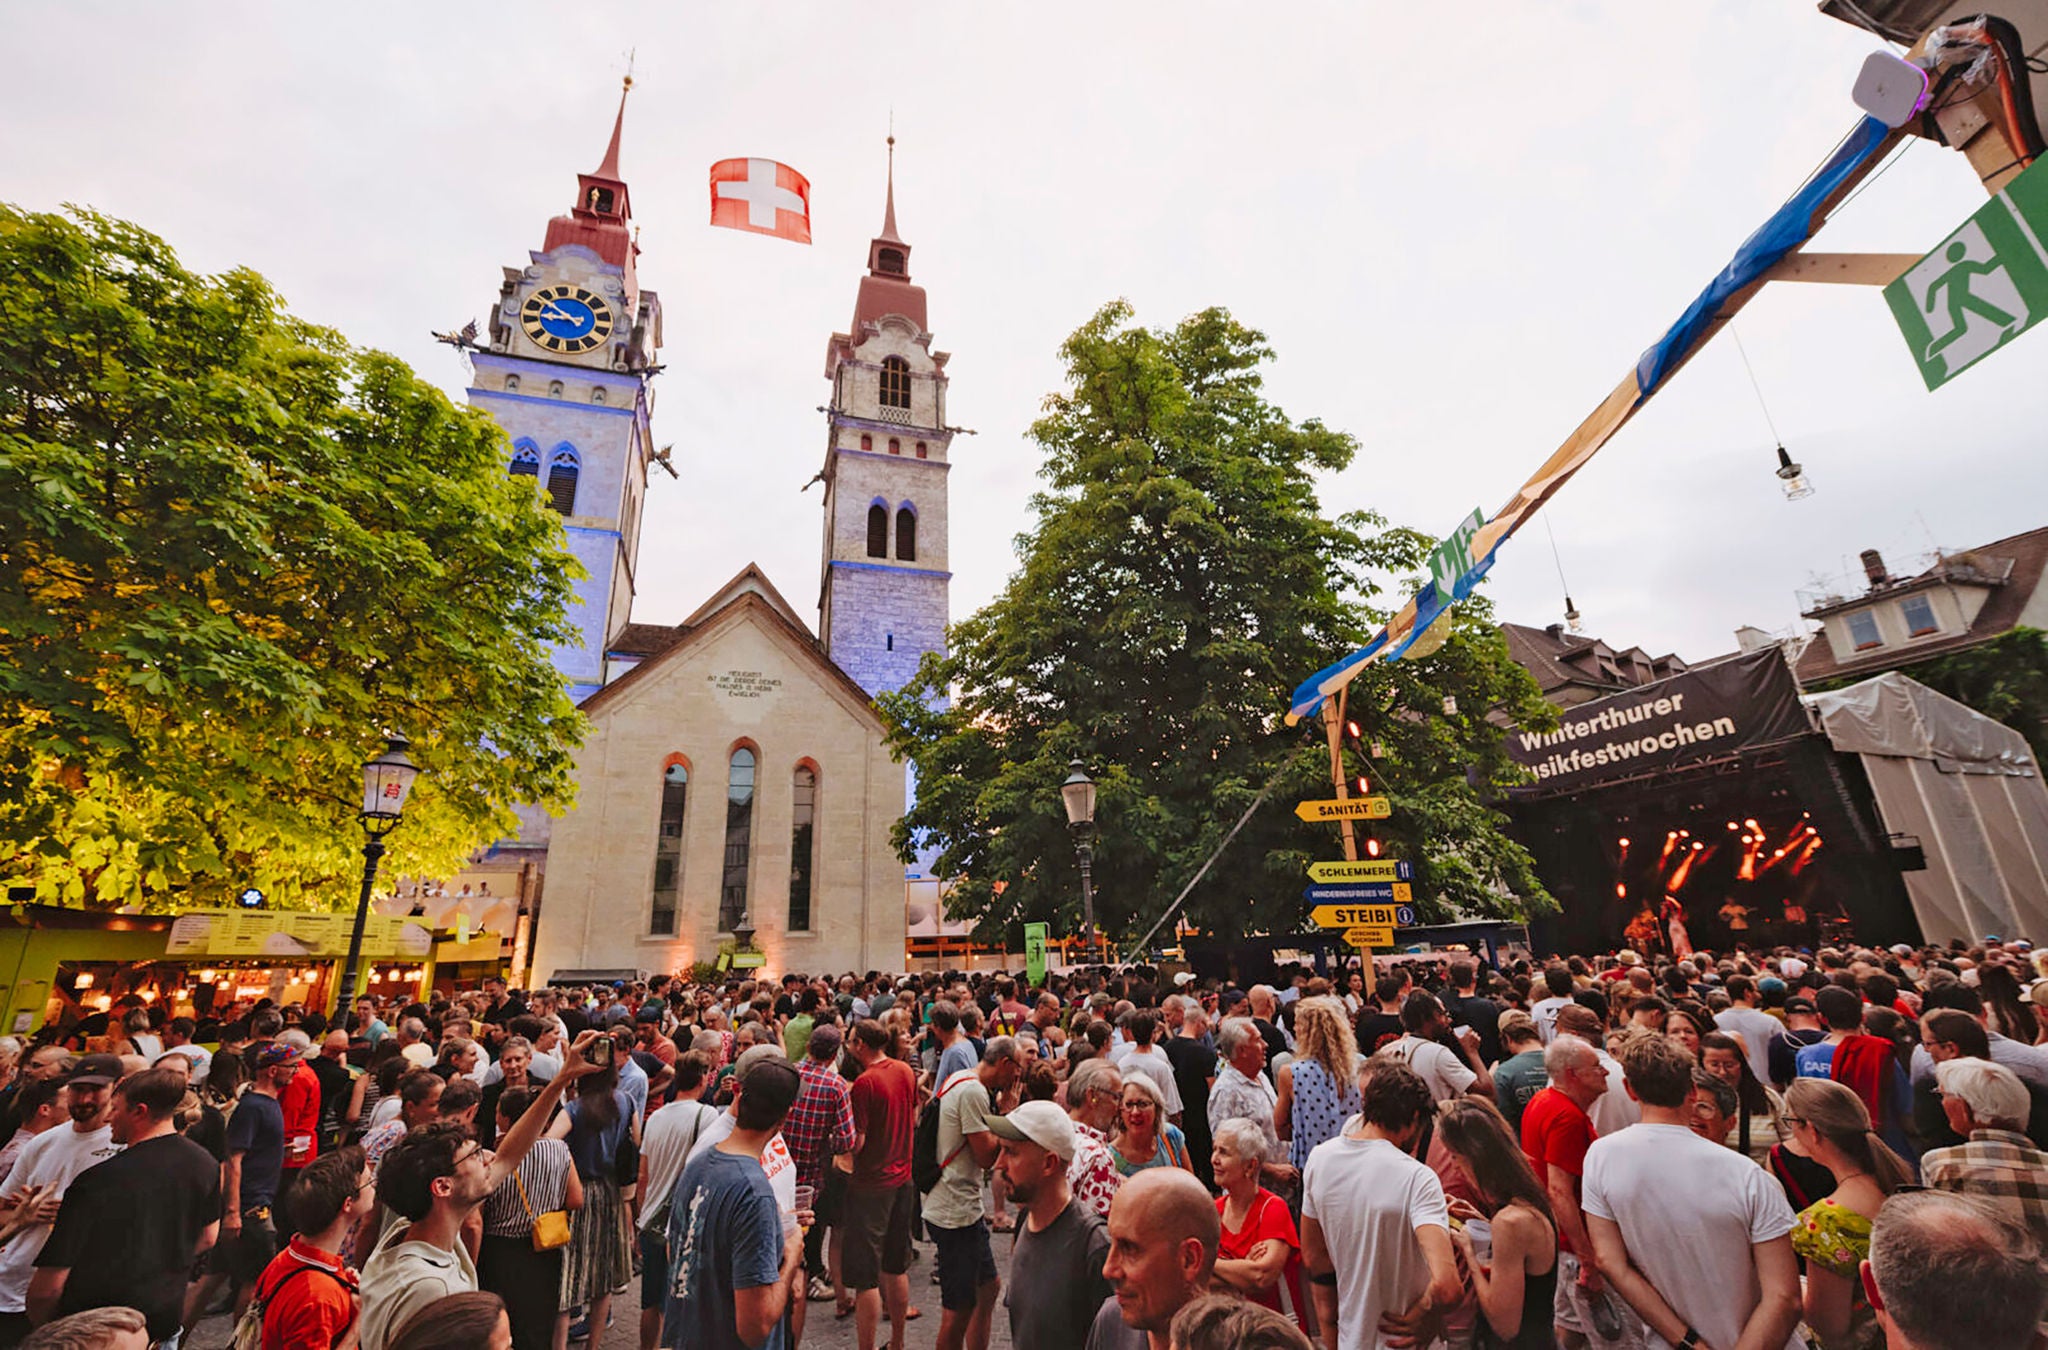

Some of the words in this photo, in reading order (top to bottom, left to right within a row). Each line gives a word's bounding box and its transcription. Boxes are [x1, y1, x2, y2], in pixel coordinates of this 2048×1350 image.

[1519, 693, 1684, 752] Winterthurer
[1526, 716, 1736, 780] usikfestwochen
[1318, 803, 1369, 816] SANITÄT
[1318, 867, 1396, 878] SCHLEMMEREI
[1378, 889, 1392, 898] WC
[1335, 910, 1392, 923] STEIBI
